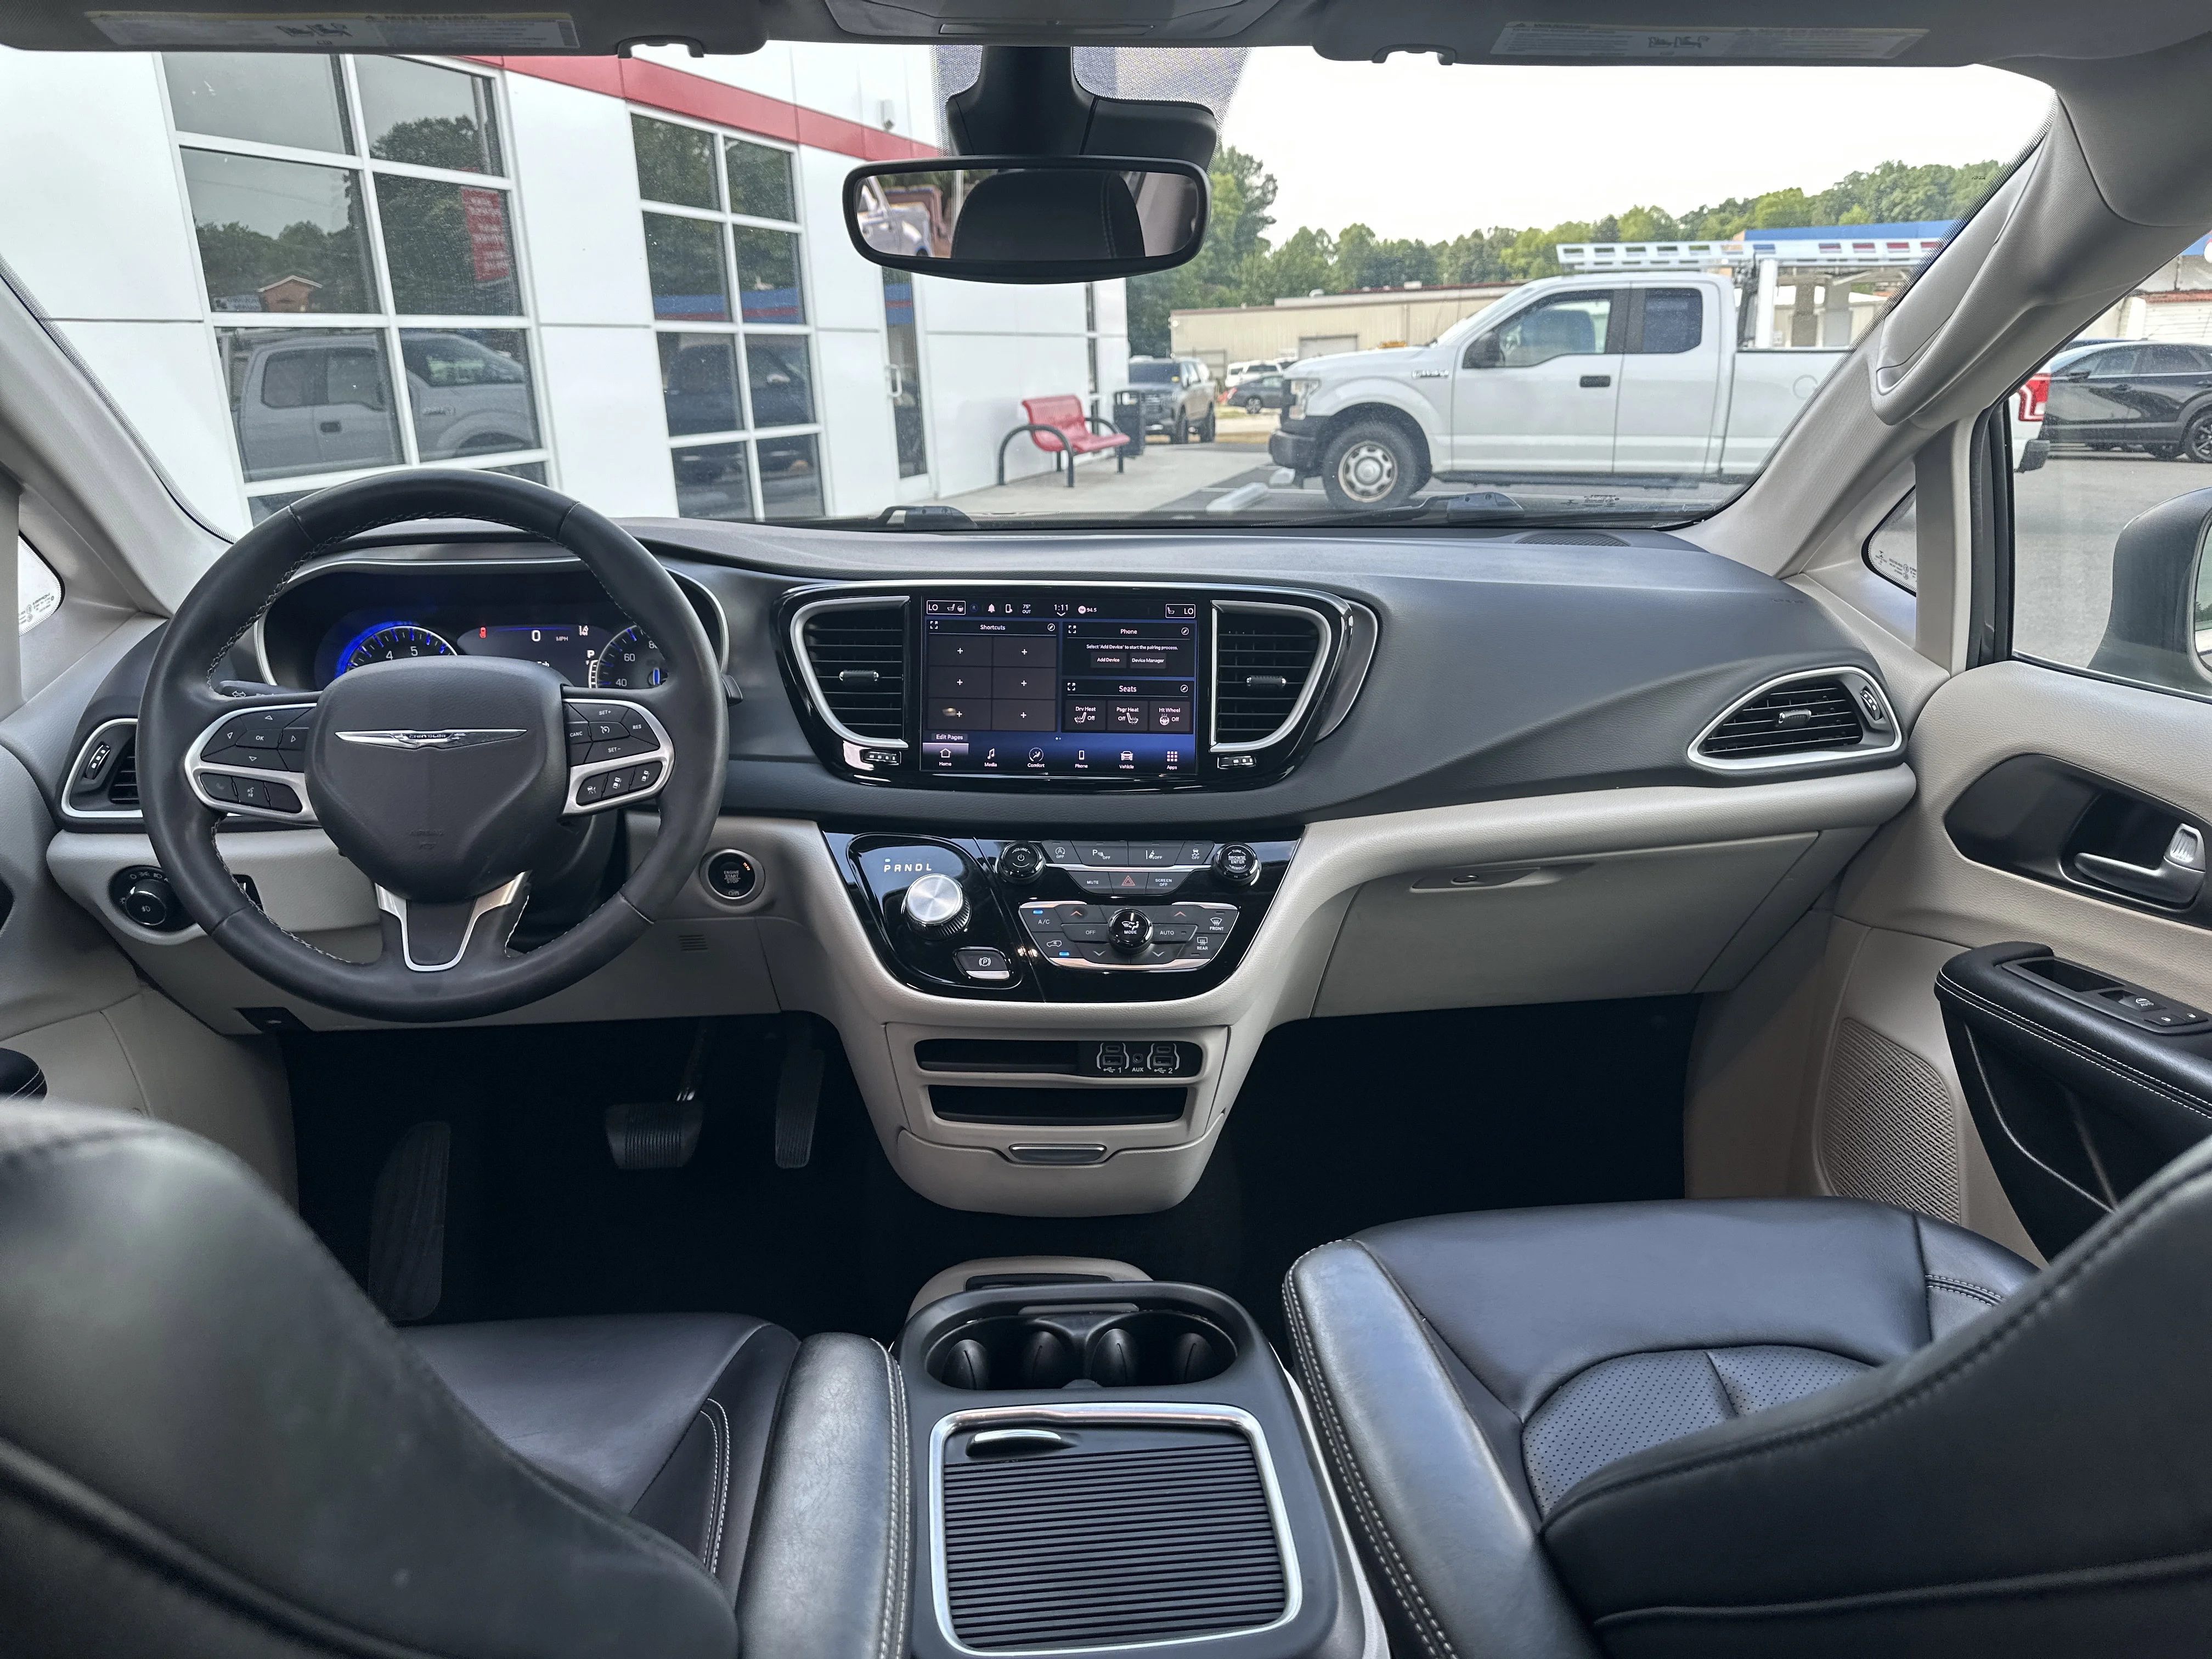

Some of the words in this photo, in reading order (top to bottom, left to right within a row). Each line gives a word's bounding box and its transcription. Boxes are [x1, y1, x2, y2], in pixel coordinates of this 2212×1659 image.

[532, 630, 541, 642] 0
[386, 651, 393, 660] 4
[410, 646, 418, 656] 5
[624, 653, 635, 662] 60
